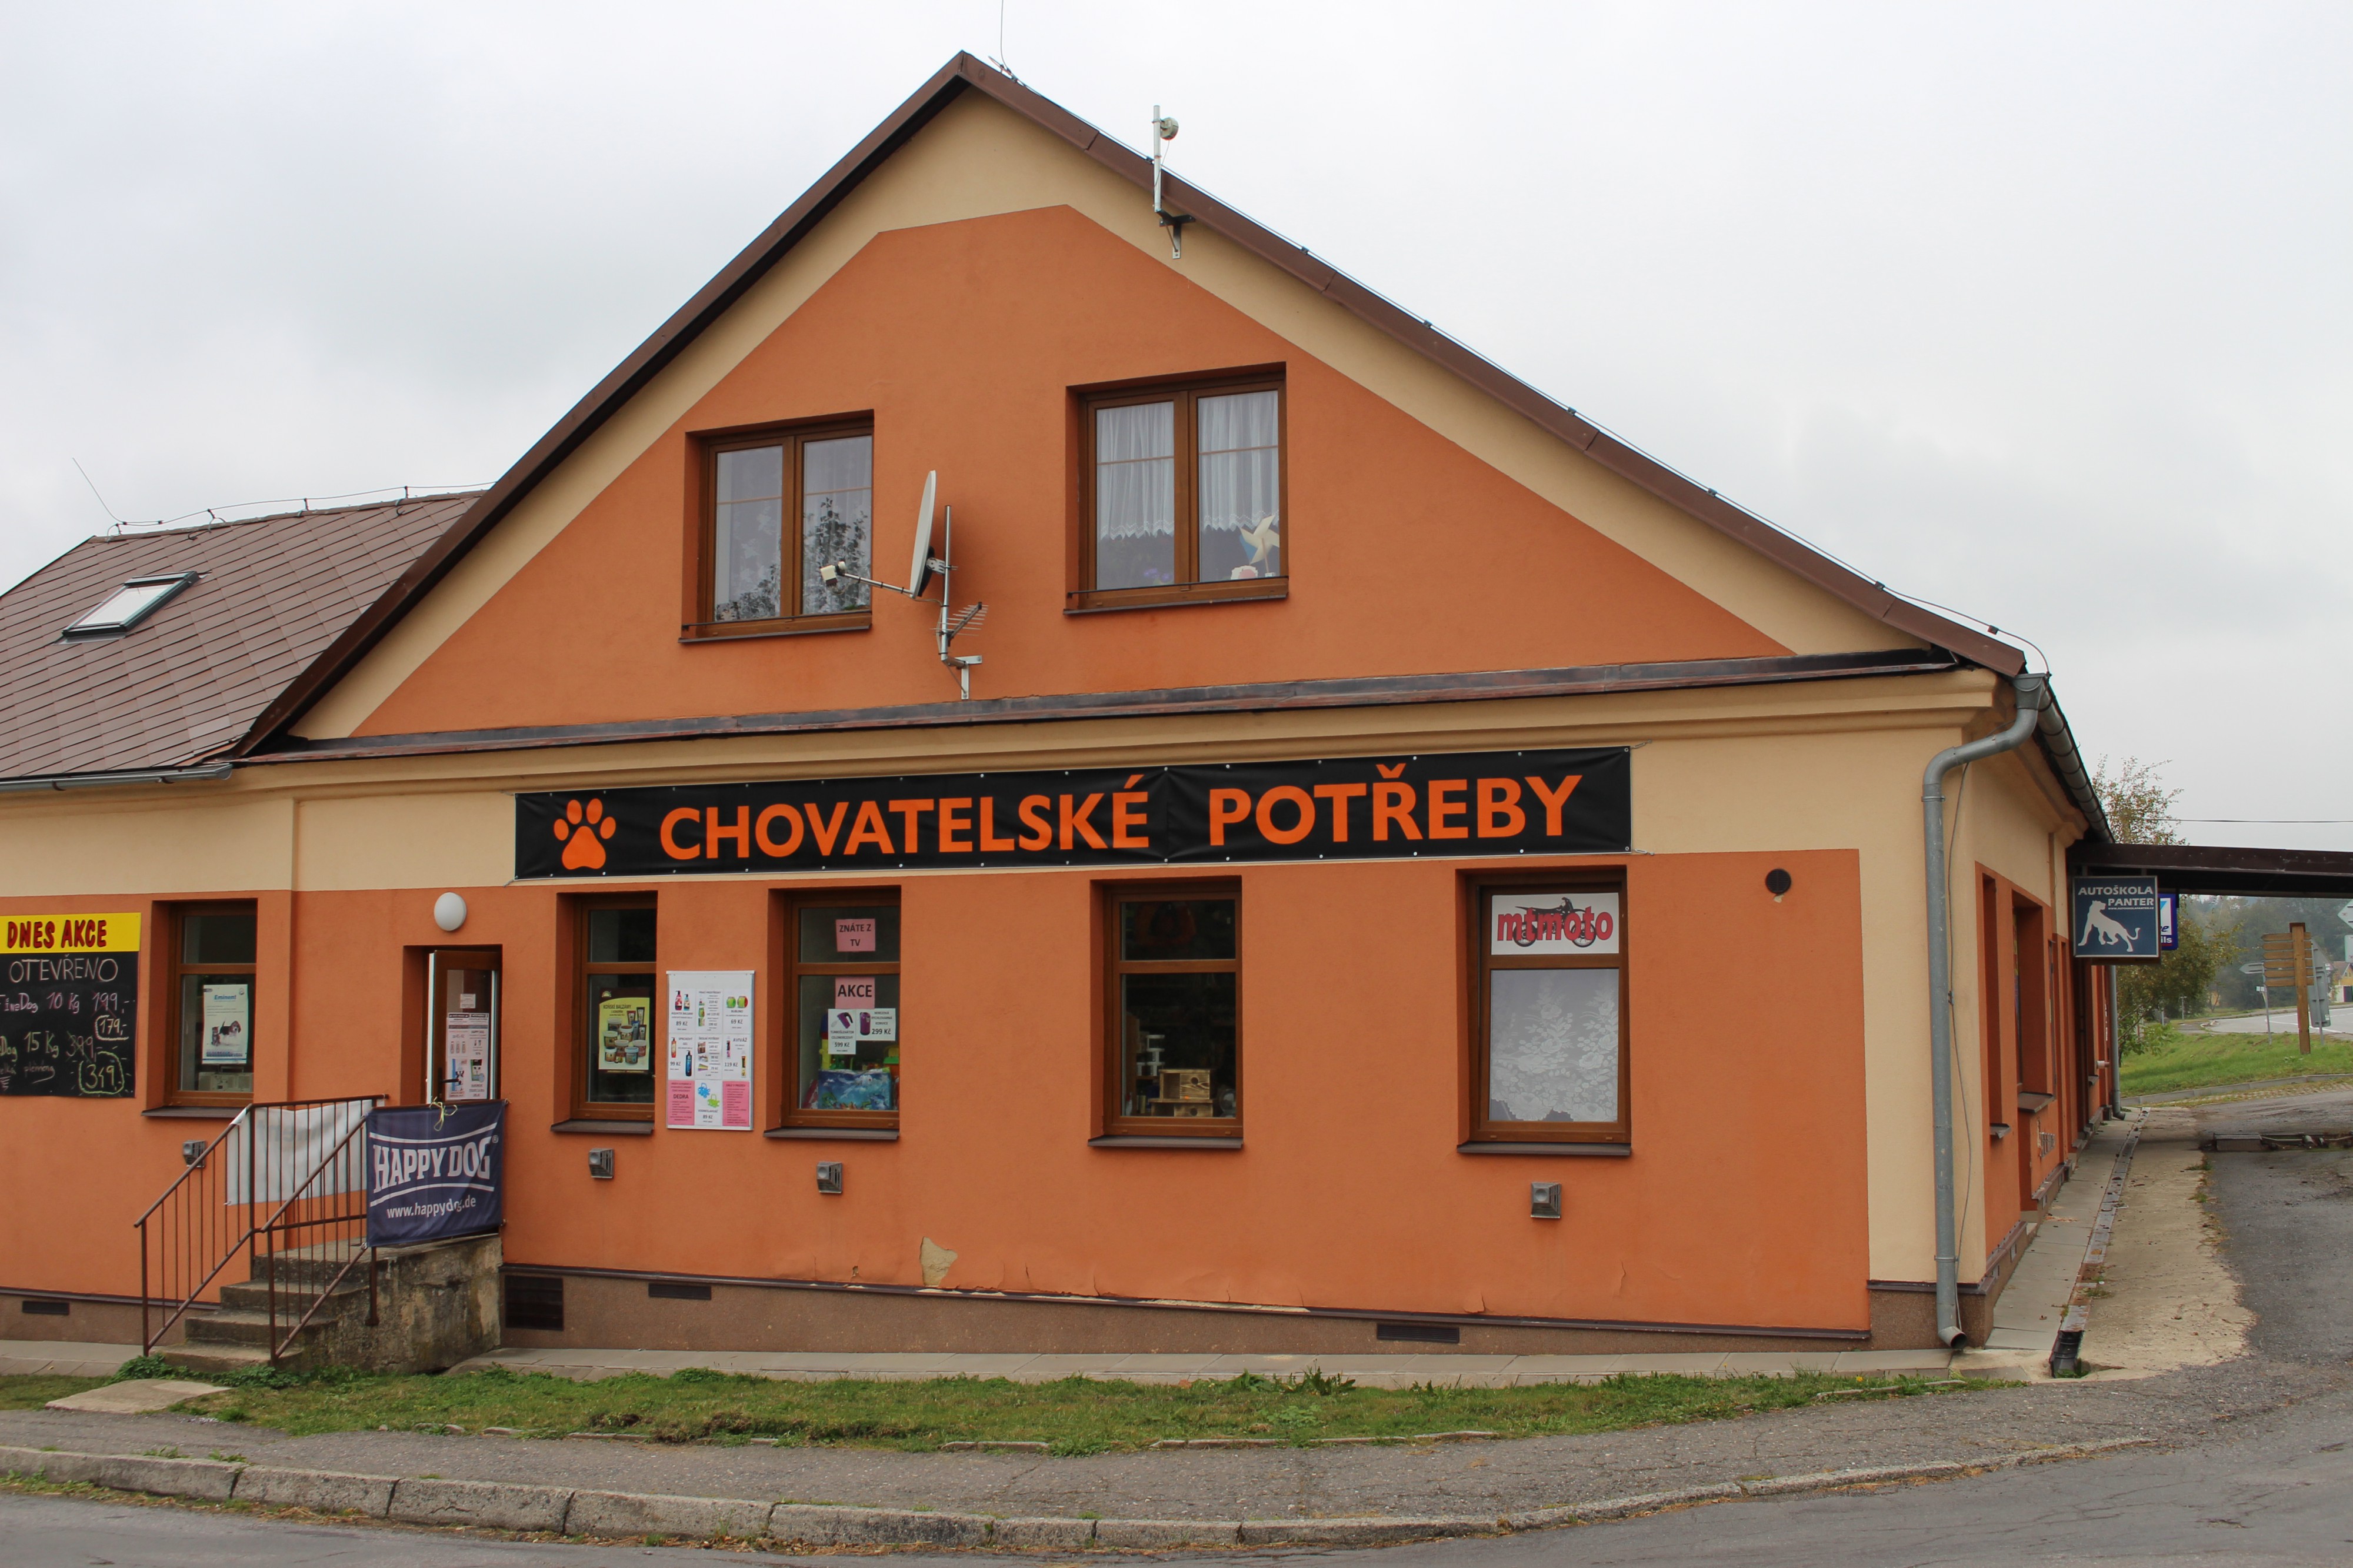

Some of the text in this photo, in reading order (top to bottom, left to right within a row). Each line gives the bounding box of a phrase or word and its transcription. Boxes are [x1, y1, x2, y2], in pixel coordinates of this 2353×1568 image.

[660, 763, 1583, 860] CHOVATELSKÉ POTŘEBY
[2078, 885, 2154, 895] AUTOŠKOLA
[7, 920, 107, 949] DNES AKCE
[839, 922, 864, 933] ZNÁTE
[1497, 906, 1614, 941] mtmoto
[9, 954, 118, 983] OTEVŘENO
[46, 992, 64, 1010] 10
[837, 984, 872, 997] AKCE
[24, 1031, 41, 1053] 15
[45, 1030, 59, 1059] Kg
[373, 1136, 492, 1193] HAPPY DOG
